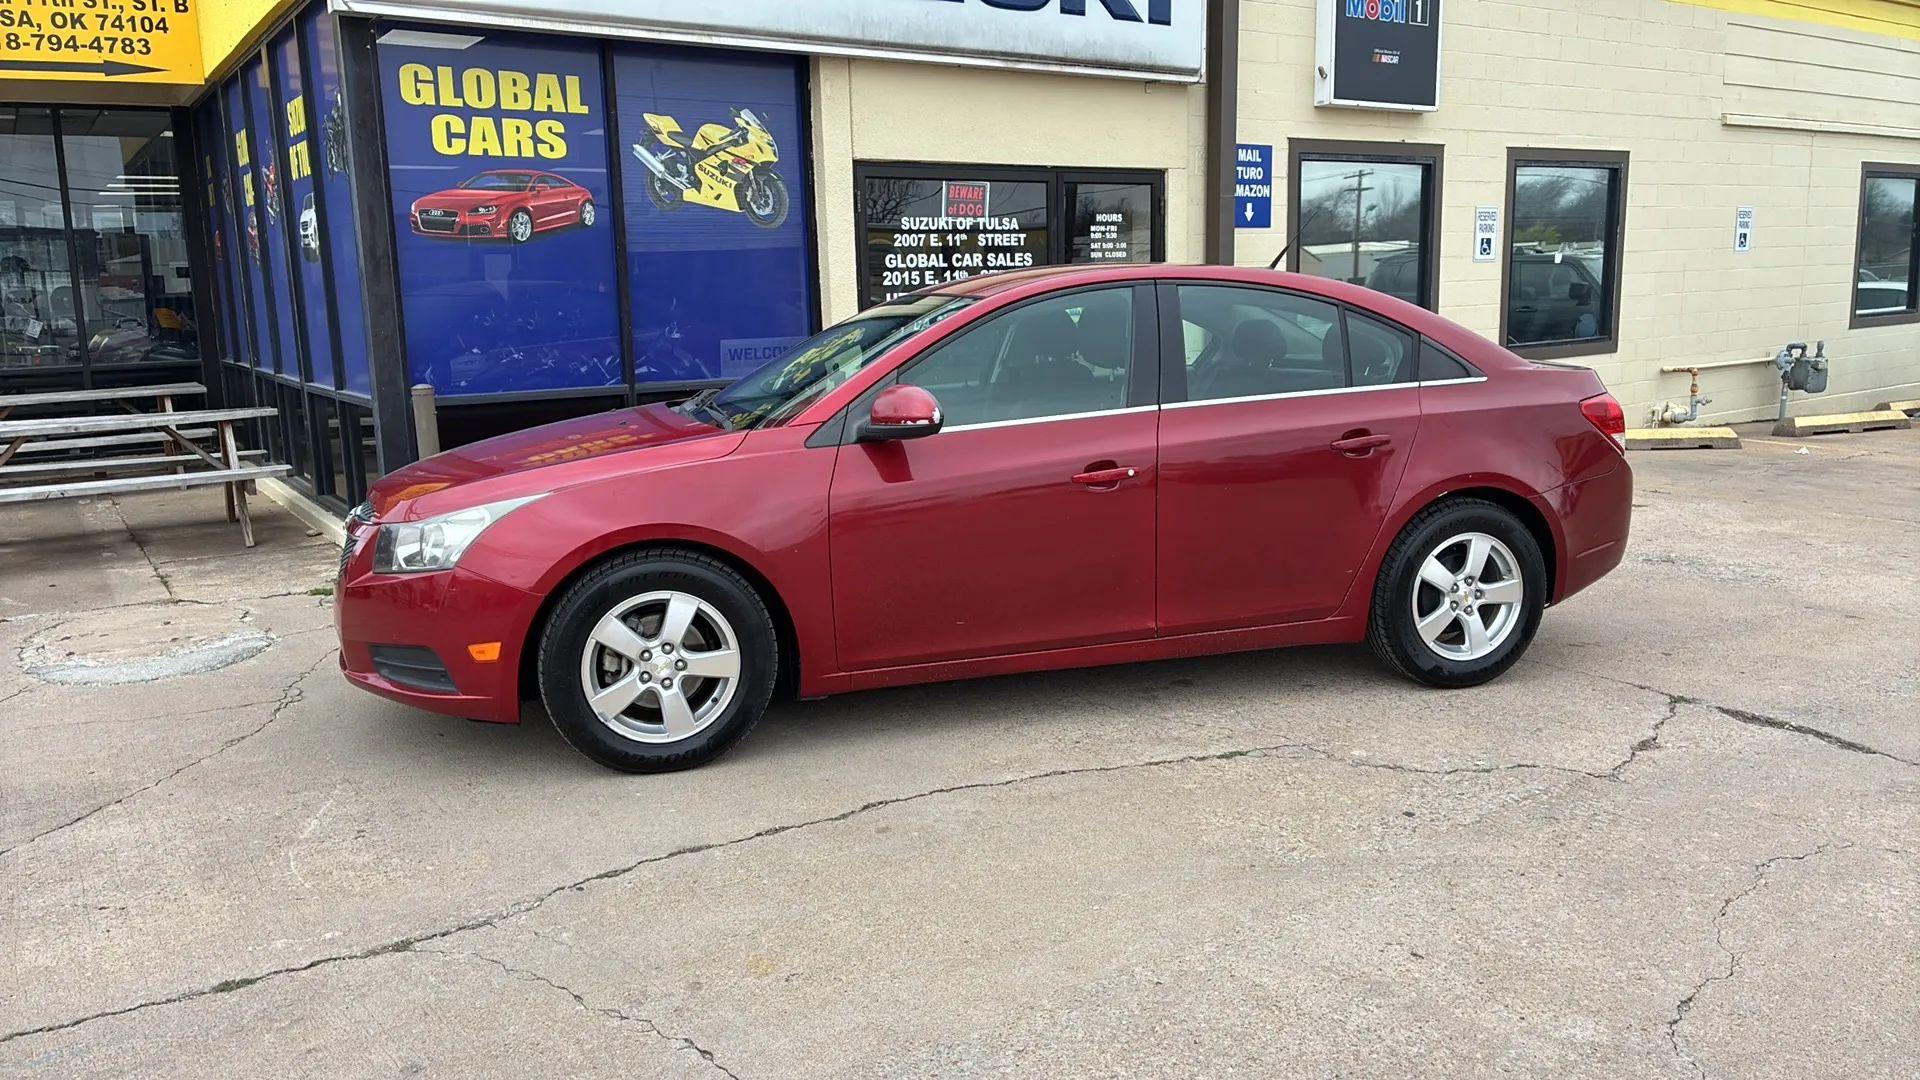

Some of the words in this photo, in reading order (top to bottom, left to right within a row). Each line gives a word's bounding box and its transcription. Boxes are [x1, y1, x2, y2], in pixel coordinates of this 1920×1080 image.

[174, 0, 189, 13] B
[1346, 0, 1406, 24] Mobil
[50, 12, 88, 30] OK
[95, 14, 169, 34] 74104
[0, 32, 151, 55] 8-794-4783
[398, 63, 589, 114] GLOBAL
[431, 114, 567, 159] CARS
[1238, 148, 1262, 162] MAIL
[698, 163, 732, 189] SUZUKI
[1236, 166, 1264, 180] TURO
[949, 186, 984, 199] BEWARE
[948, 204, 957, 215] of
[959, 203, 983, 216] DOG
[901, 217, 952, 230] SUZUKI
[956, 217, 974, 230] OF
[979, 217, 1019, 230] TULSA
[1096, 213, 1123, 222] HOURS
[893, 234, 925, 247] 2007
[930, 233, 943, 247] E.
[946, 233, 968, 247] 11th
[977, 233, 1027, 247] STREET
[884, 253, 948, 268] GLOBAL
[952, 253, 983, 267] CAR
[987, 252, 1033, 267] SALES
[882, 270, 921, 286] 2015
[925, 270, 939, 285] E.
